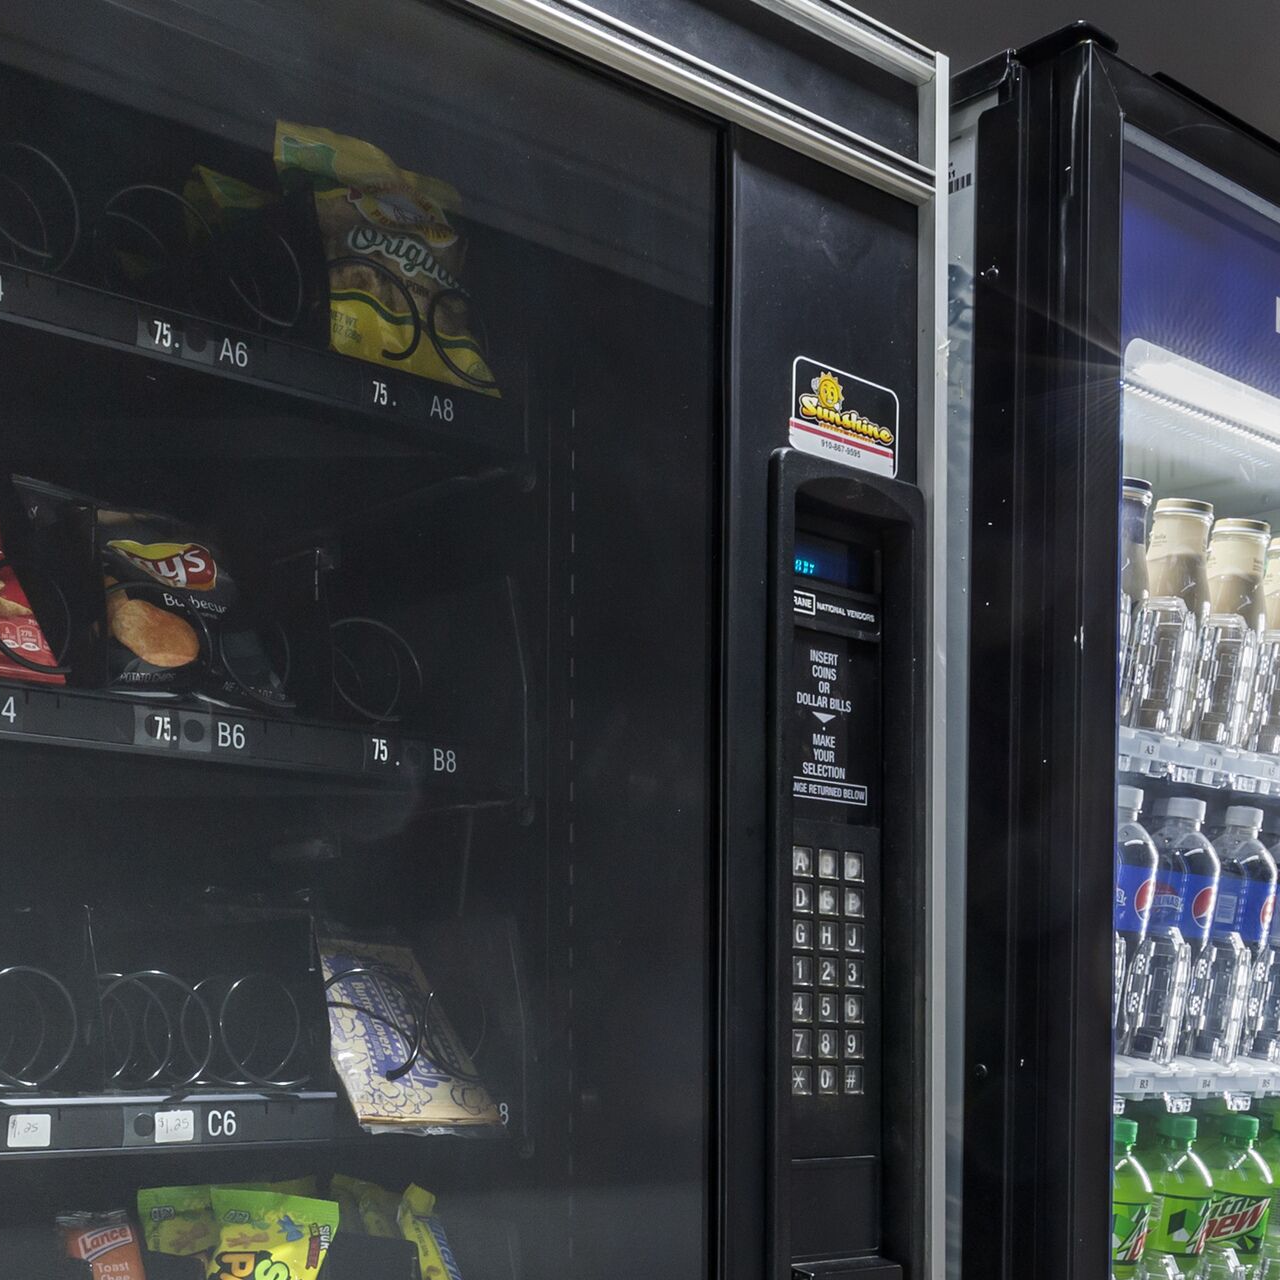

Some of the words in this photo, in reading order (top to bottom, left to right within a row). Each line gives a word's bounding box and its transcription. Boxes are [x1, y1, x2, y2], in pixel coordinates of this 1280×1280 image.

[219, 339, 249, 369] A6
[430, 395, 455, 422] A8
[800, 393, 895, 446] Sunshine
[816, 601, 846, 616] NATIONAL
[847, 608, 875, 623] VENDORS
[810, 649, 839, 667] INSERT
[812, 665, 837, 682] COINS
[819, 681, 831, 695] OR
[796, 691, 828, 709] DOLLAR
[830, 697, 852, 713] BILLS
[218, 722, 246, 750] B6
[813, 733, 836, 749] MAKE
[432, 749, 457, 773] B8
[813, 748, 835, 764] YOUR
[803, 762, 846, 780] SELECTION
[809, 783, 842, 798] RETURNED
[843, 789, 865, 801] BELOW
[795, 889, 805, 907] D
[795, 925, 805, 943] G
[822, 926, 831, 945] H
[822, 962, 830, 981] 2
[822, 997, 830, 1016] 5
[847, 1034, 856, 1053] 9
[208, 1111, 237, 1138] C6
[80, 1227, 129, 1254] Lance
